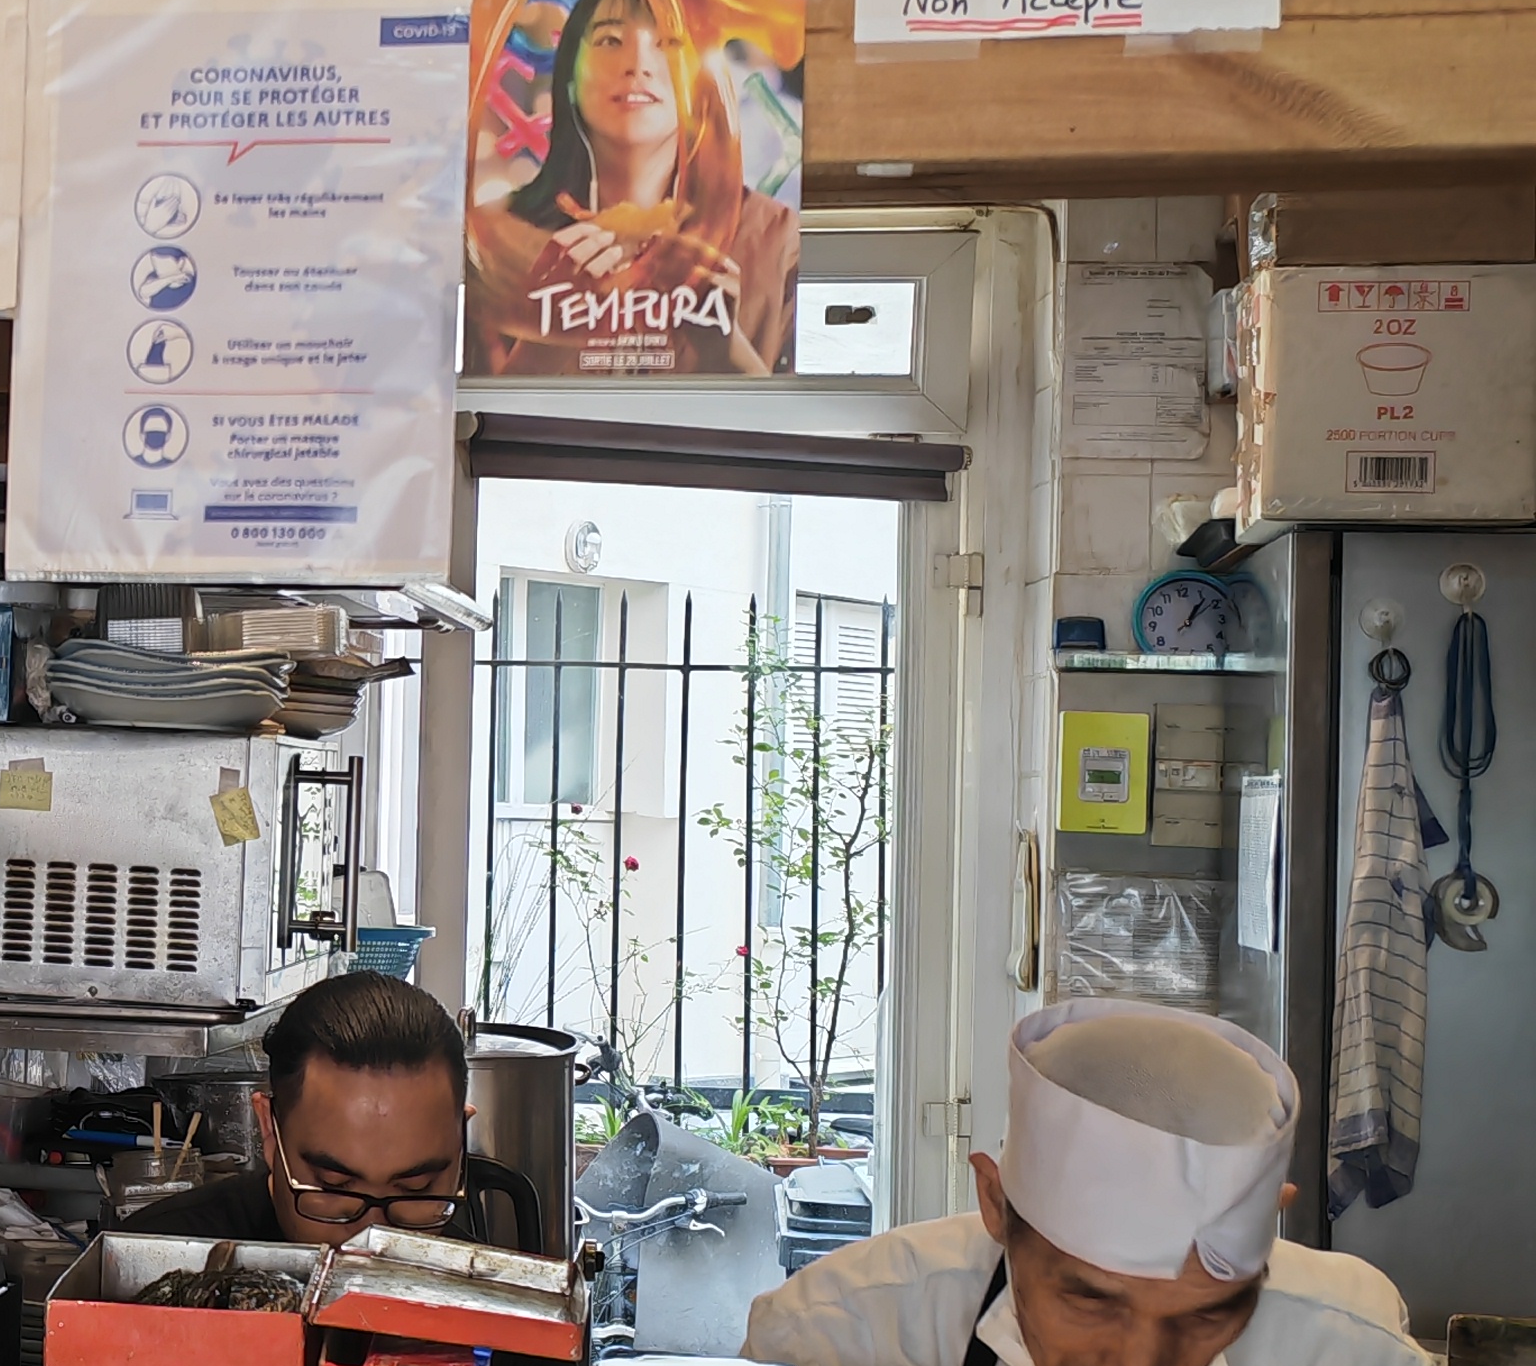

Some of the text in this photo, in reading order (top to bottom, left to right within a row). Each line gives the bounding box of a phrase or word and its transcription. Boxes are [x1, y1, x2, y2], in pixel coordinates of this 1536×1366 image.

[190, 65, 342, 85] CORONAVIRUS,
[171, 85, 360, 107] POUR SE PROTÉGER
[141, 109, 390, 129] ET PROTÉGER LES AUTRES
[528, 282, 731, 337] TEMPURA
[1376, 406, 1414, 420] PL2
